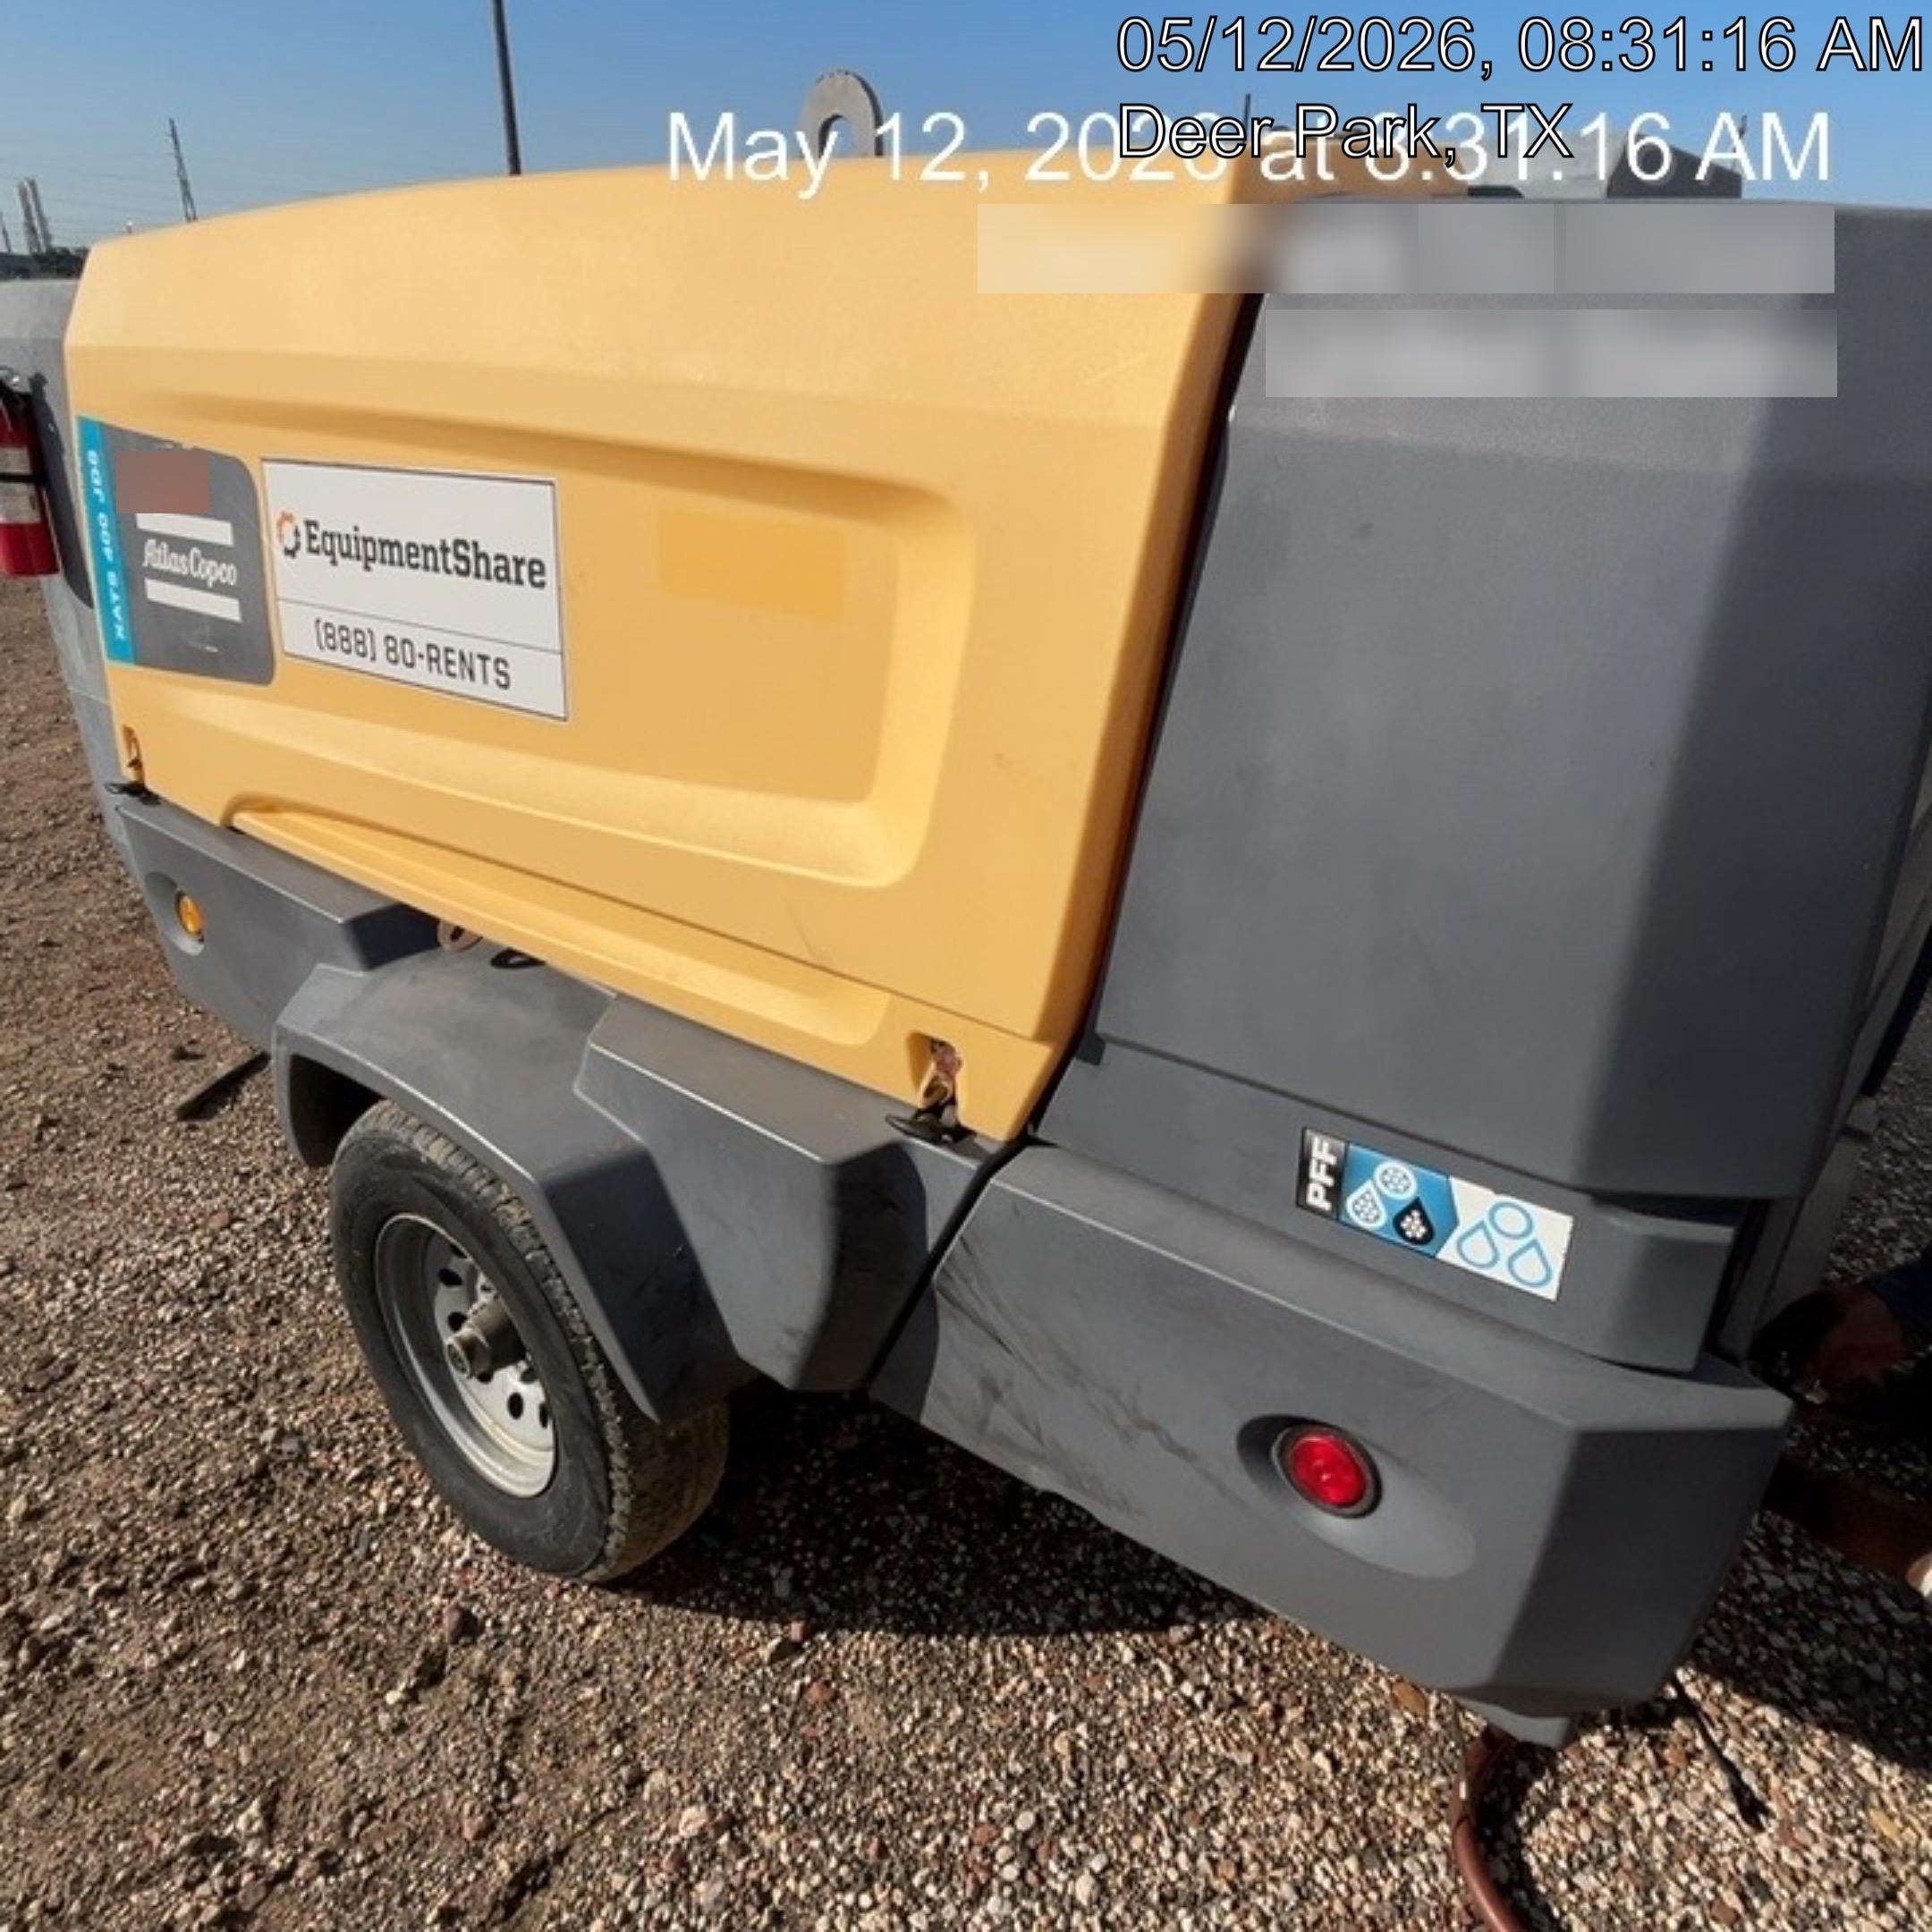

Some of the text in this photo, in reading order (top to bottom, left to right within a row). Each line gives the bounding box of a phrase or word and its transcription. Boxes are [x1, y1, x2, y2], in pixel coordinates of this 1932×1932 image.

[97, 512, 114, 563] 400
[142, 538, 238, 588] Atlas Copco
[303, 519, 547, 589] EquipmentShare
[315, 617, 512, 691] (888) 80-RENTS
[1306, 1137, 1339, 1212] PFF
